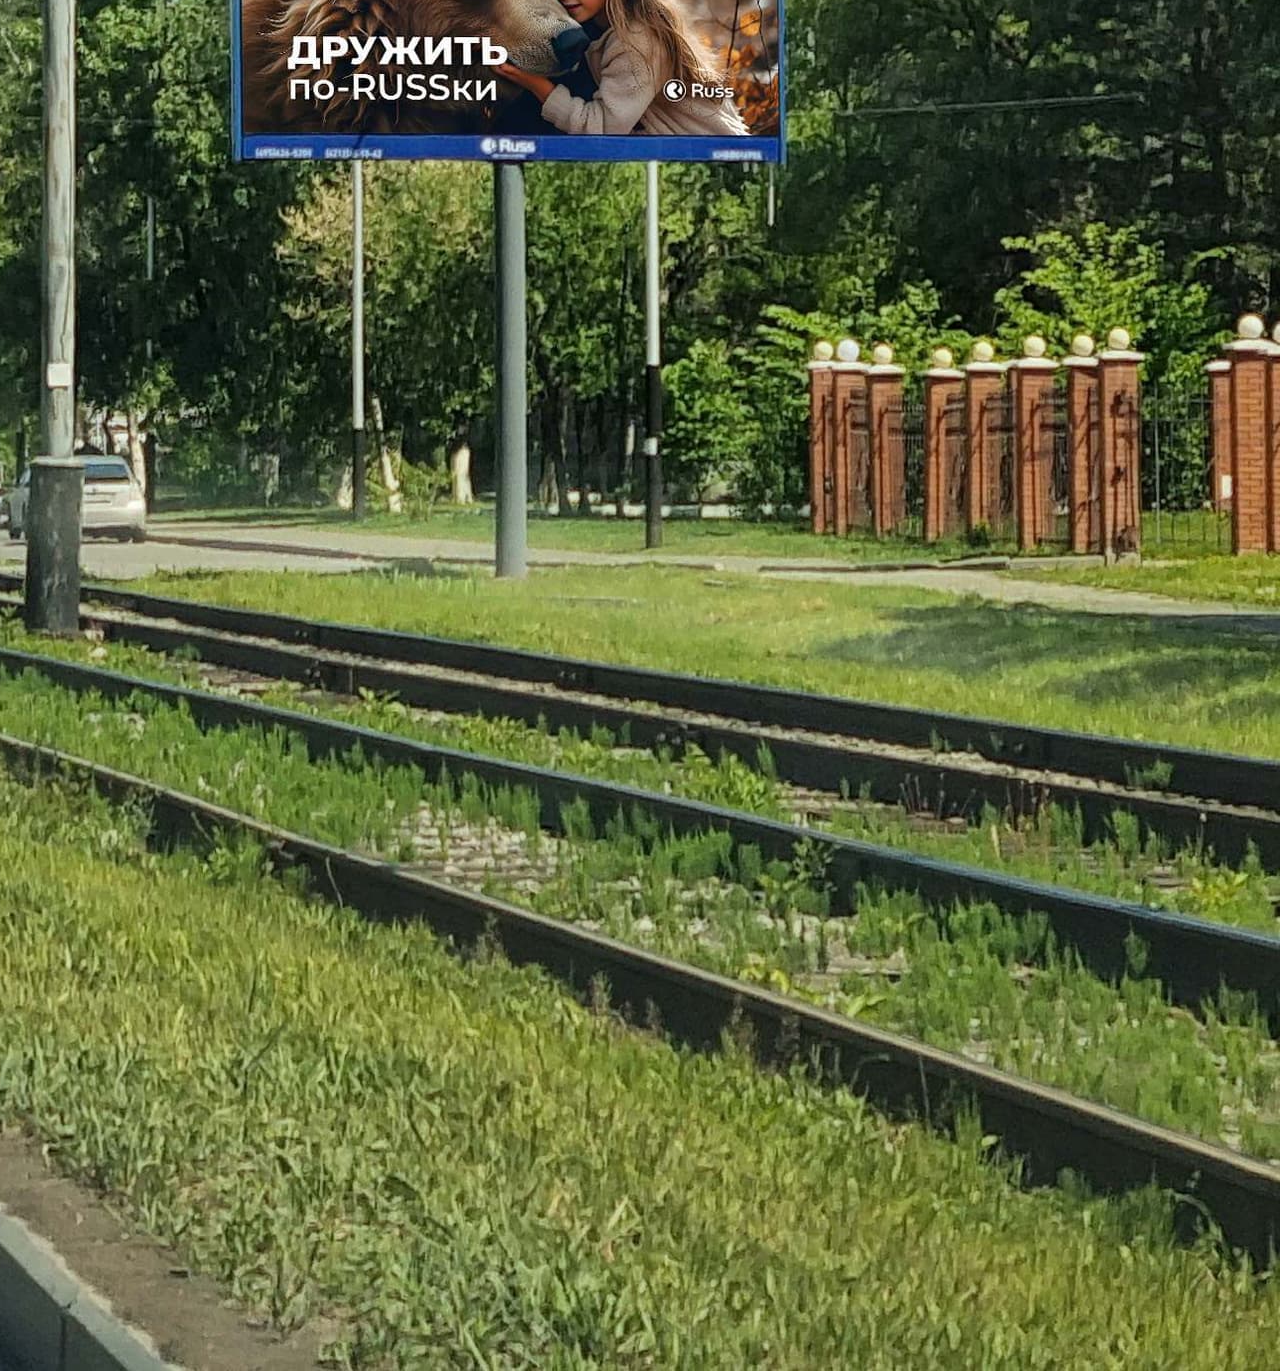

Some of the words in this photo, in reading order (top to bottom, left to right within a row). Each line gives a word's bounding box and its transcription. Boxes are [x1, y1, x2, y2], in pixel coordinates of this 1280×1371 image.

[287, 35, 508, 70] ДРУЖИТЬ
[290, 73, 497, 102] по-RUSSки
[691, 83, 735, 99] Russ
[498, 138, 537, 154] Russ
